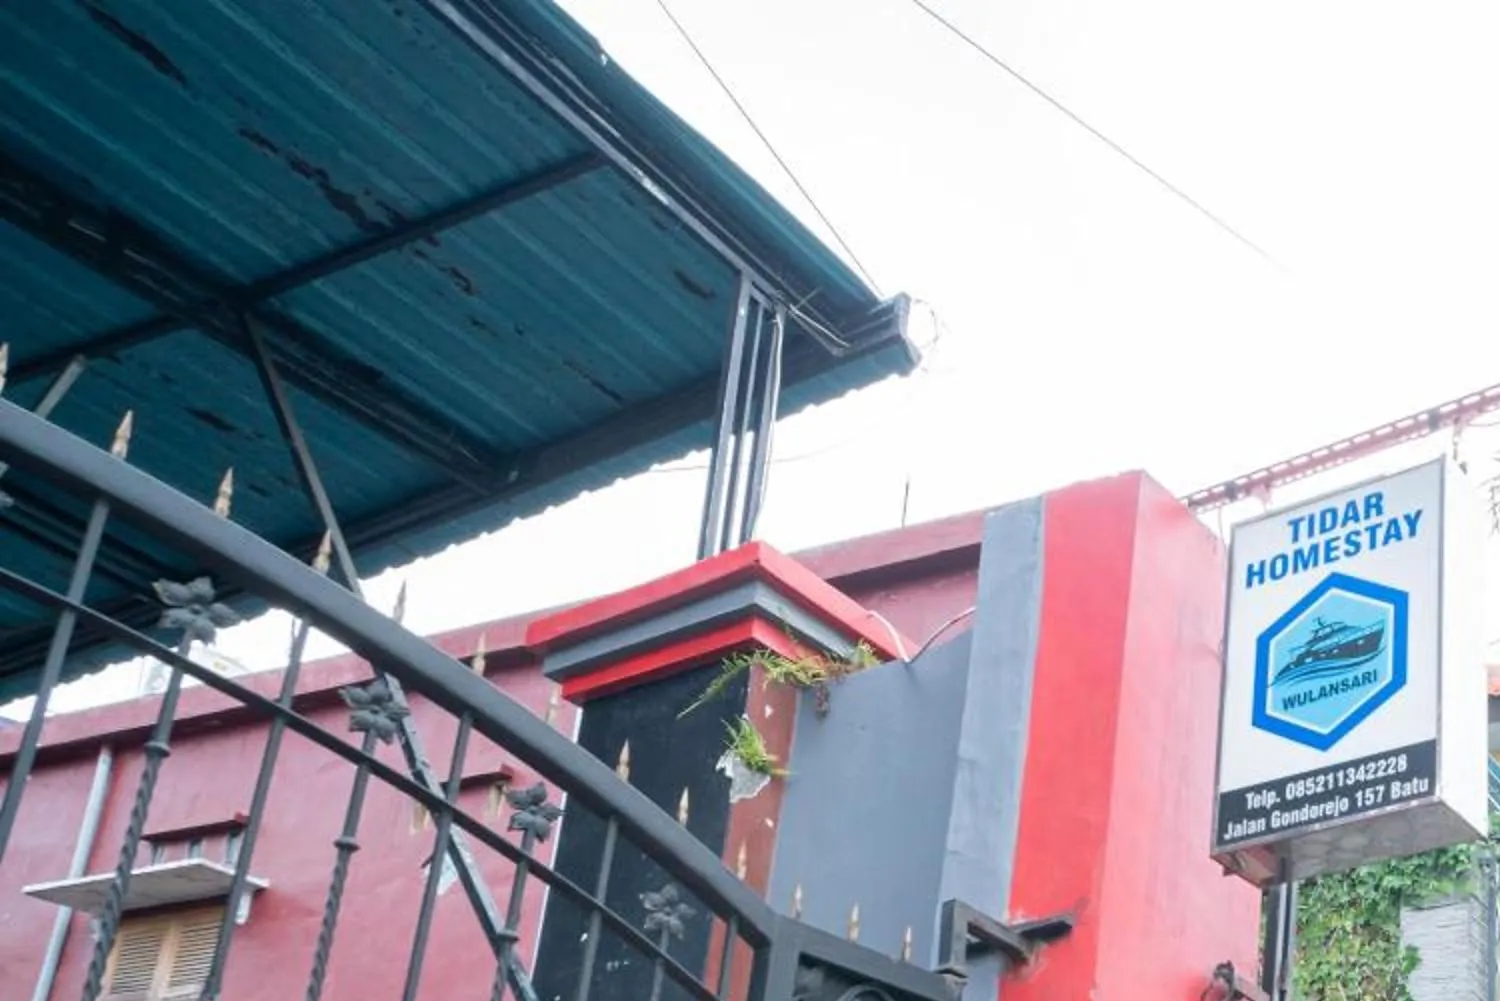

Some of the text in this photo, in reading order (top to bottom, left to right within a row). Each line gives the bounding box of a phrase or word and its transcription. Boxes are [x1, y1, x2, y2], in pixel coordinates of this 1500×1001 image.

[1287, 491, 1384, 544] TIDAR
[1245, 508, 1423, 589] HOMESTAY
[1281, 668, 1378, 711] WULANSARI
[1223, 777, 1429, 840] Jalan Gondorejo 157 Batu
[1245, 753, 1408, 811] Telp. 085211342228
